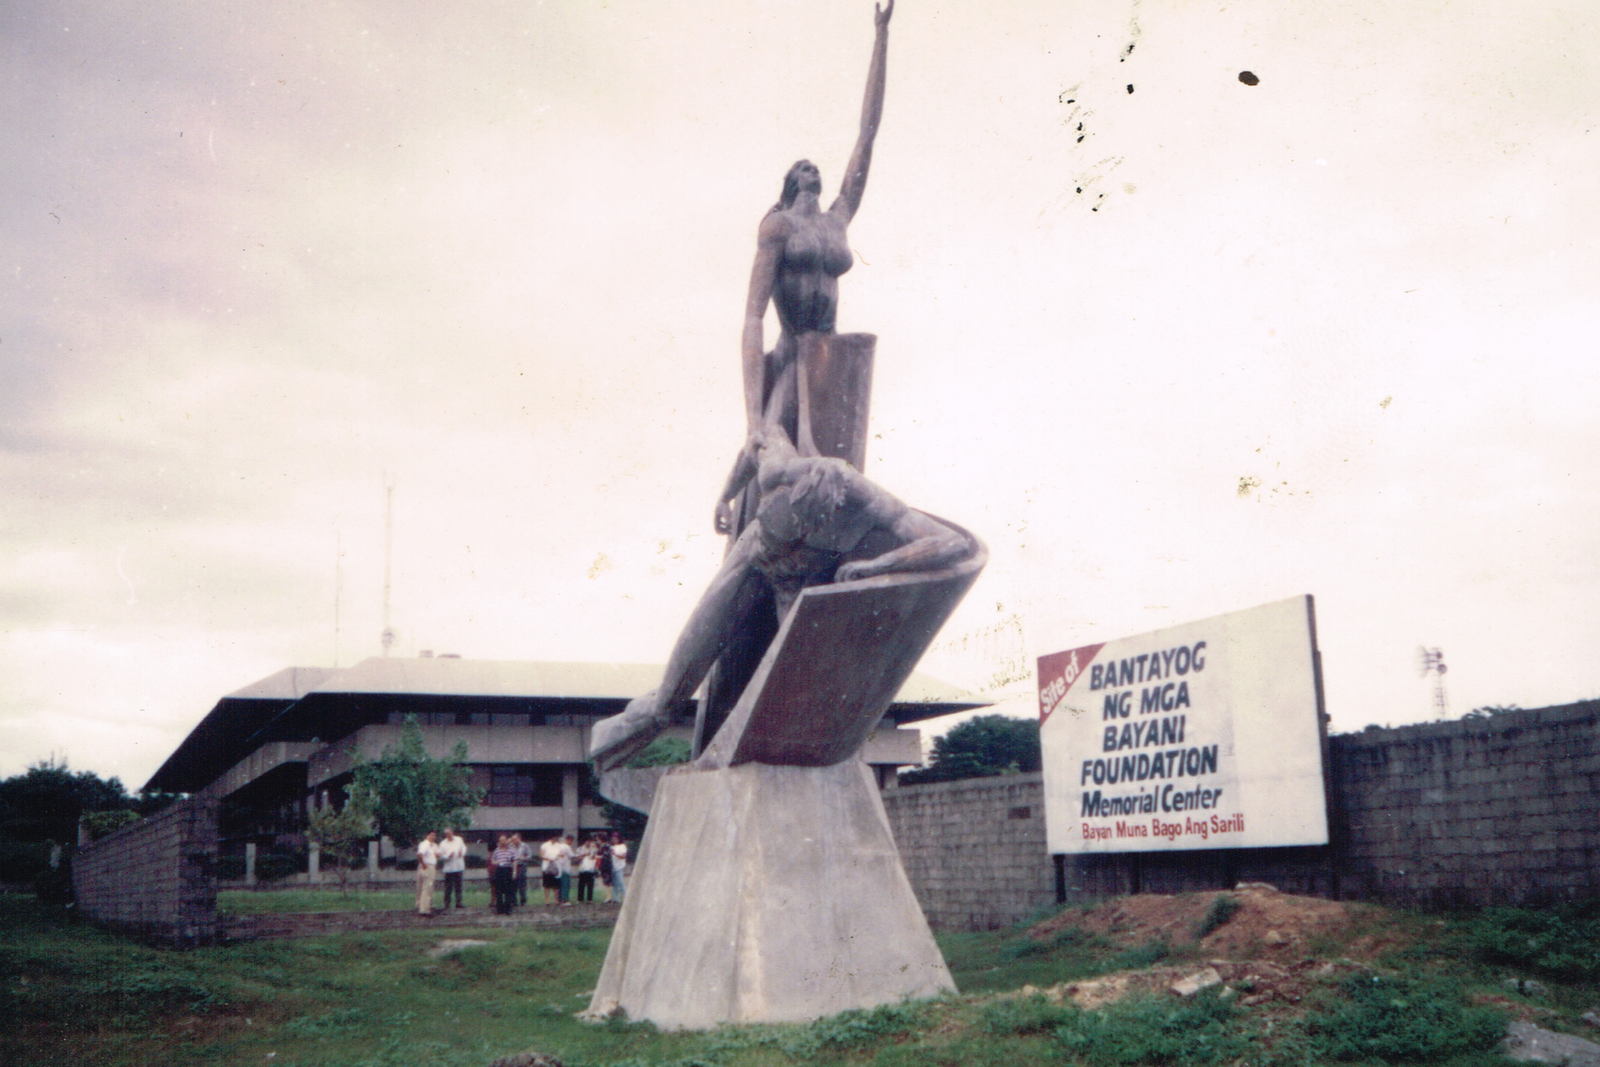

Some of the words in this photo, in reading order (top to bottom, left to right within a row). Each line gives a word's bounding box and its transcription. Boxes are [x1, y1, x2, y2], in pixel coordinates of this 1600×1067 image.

[1040, 677, 1066, 714] Site
[1063, 650, 1080, 684] of
[1090, 641, 1207, 691] BANTAYOG
[1102, 691, 1131, 720] NG
[1140, 681, 1190, 715] MGA
[1102, 715, 1186, 752] BAYANI
[1081, 744, 1219, 786] FOUNDATION
[1080, 786, 1159, 818] Memorial
[1161, 783, 1223, 813] Center
[1082, 823, 1112, 842] Bayan
[1116, 820, 1148, 838] Muna
[1152, 818, 1182, 841] Bago
[1185, 817, 1208, 839] Ang
[1210, 813, 1245, 834] Sarili
